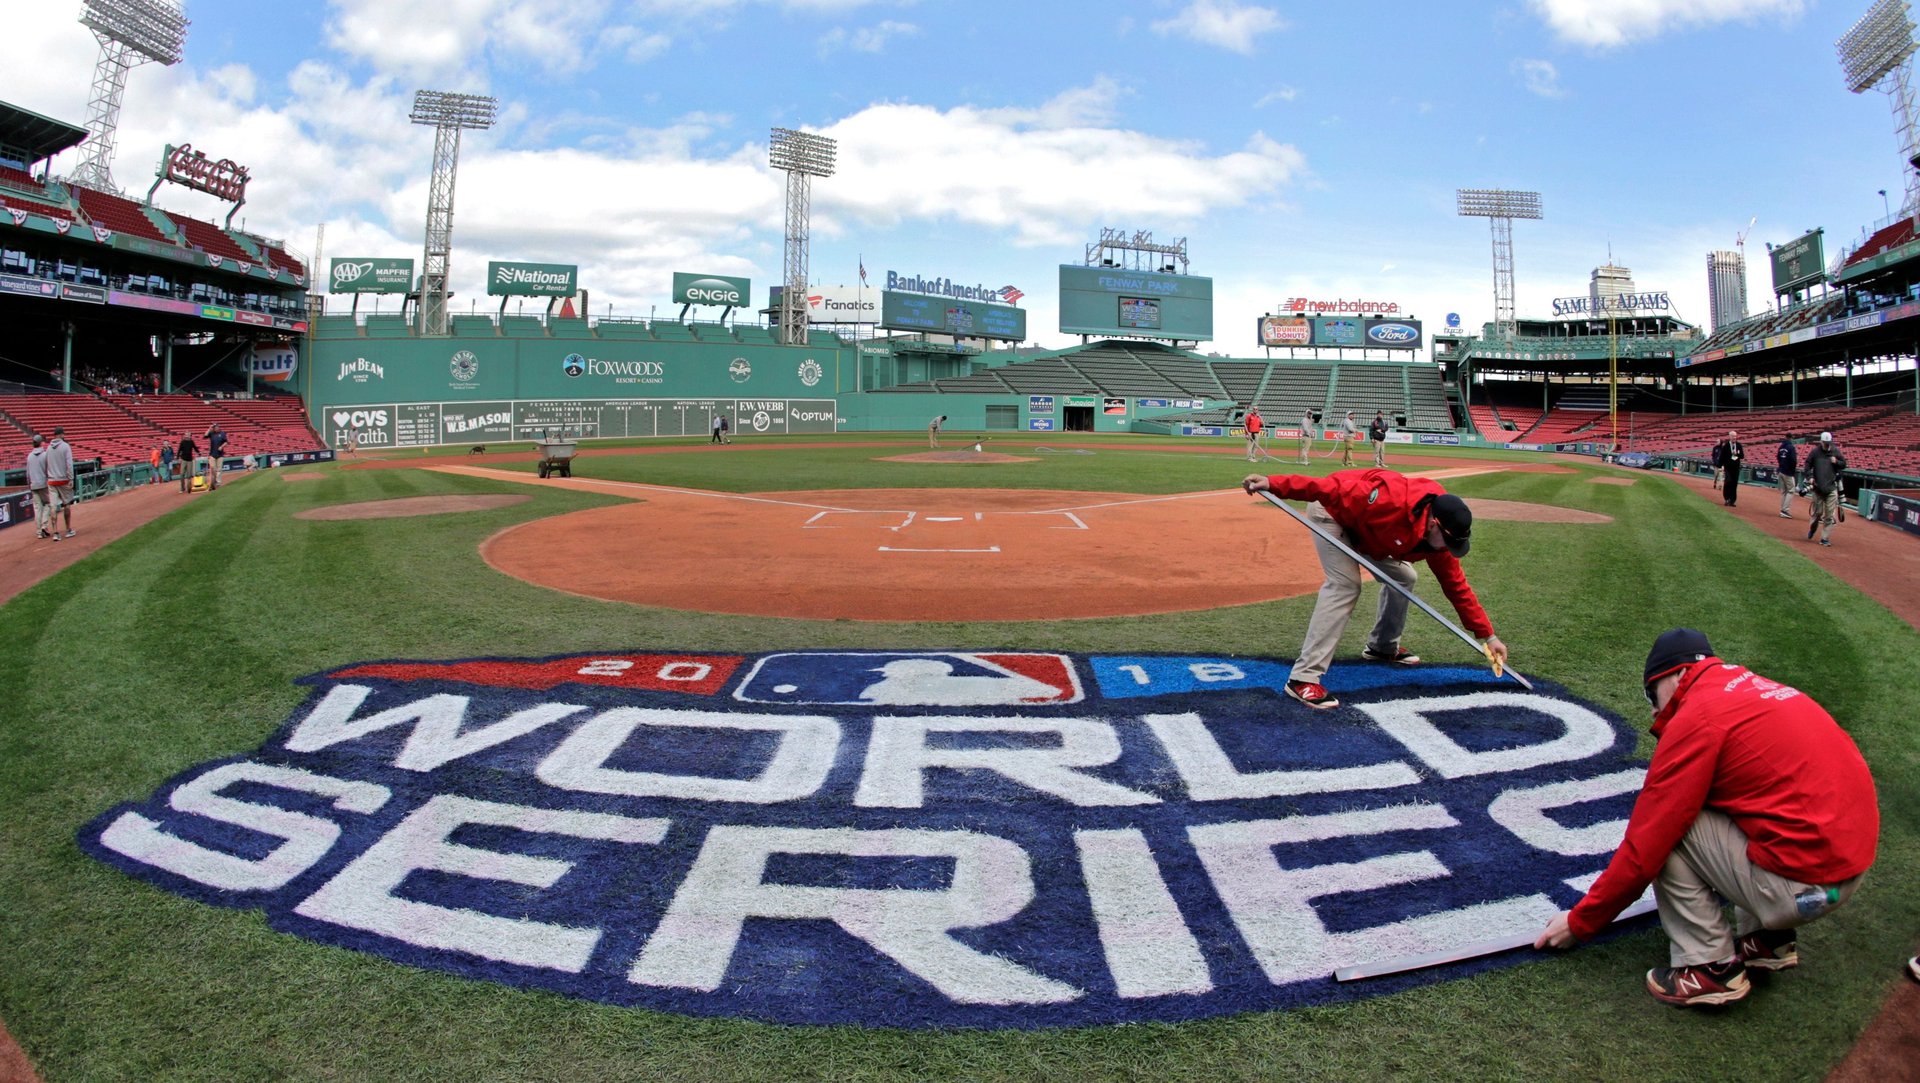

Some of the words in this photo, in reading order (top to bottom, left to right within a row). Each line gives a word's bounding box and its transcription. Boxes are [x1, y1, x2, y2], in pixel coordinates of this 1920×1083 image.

[168, 143, 250, 203] Coca-Cola
[1778, 248, 1796, 262] FENWAY
[1796, 243, 1809, 255] PARK
[337, 263, 358, 281] AAA
[376, 268, 410, 276] MAPFRE
[513, 270, 570, 284] National
[887, 270, 926, 293] Bank
[926, 277, 941, 294] of
[942, 278, 996, 303] America
[1099, 277, 1144, 289] FENWAY
[1148, 280, 1178, 292] PARK
[825, 299, 874, 310] Fanatics
[1122, 305, 1158, 313] WORLD
[1308, 300, 1337, 312] new
[1338, 298, 1397, 312] balance
[1553, 297, 1609, 316] SAMUEL
[1617, 292, 1669, 310] ADAMS
[1122, 312, 1157, 321] SERIES
[1378, 326, 1407, 340] Ford
[450, 352, 460, 365] RED
[462, 352, 473, 360] SOX
[338, 362, 356, 381] JIM
[357, 358, 384, 379] BEAM
[453, 362, 477, 380] SCHOLARS
[588, 358, 663, 376] FOXWOODS
[740, 402, 756, 411] F.W.
[758, 402, 784, 411] WEBB
[351, 410, 388, 428] CVS
[801, 412, 832, 421] OPTUM
[336, 429, 388, 445] Halth
[1191, 427, 1213, 435] jetBlue
[577, 660, 711, 682] 20
[1119, 663, 1246, 684] 18
[284, 684, 1617, 808] WORLD
